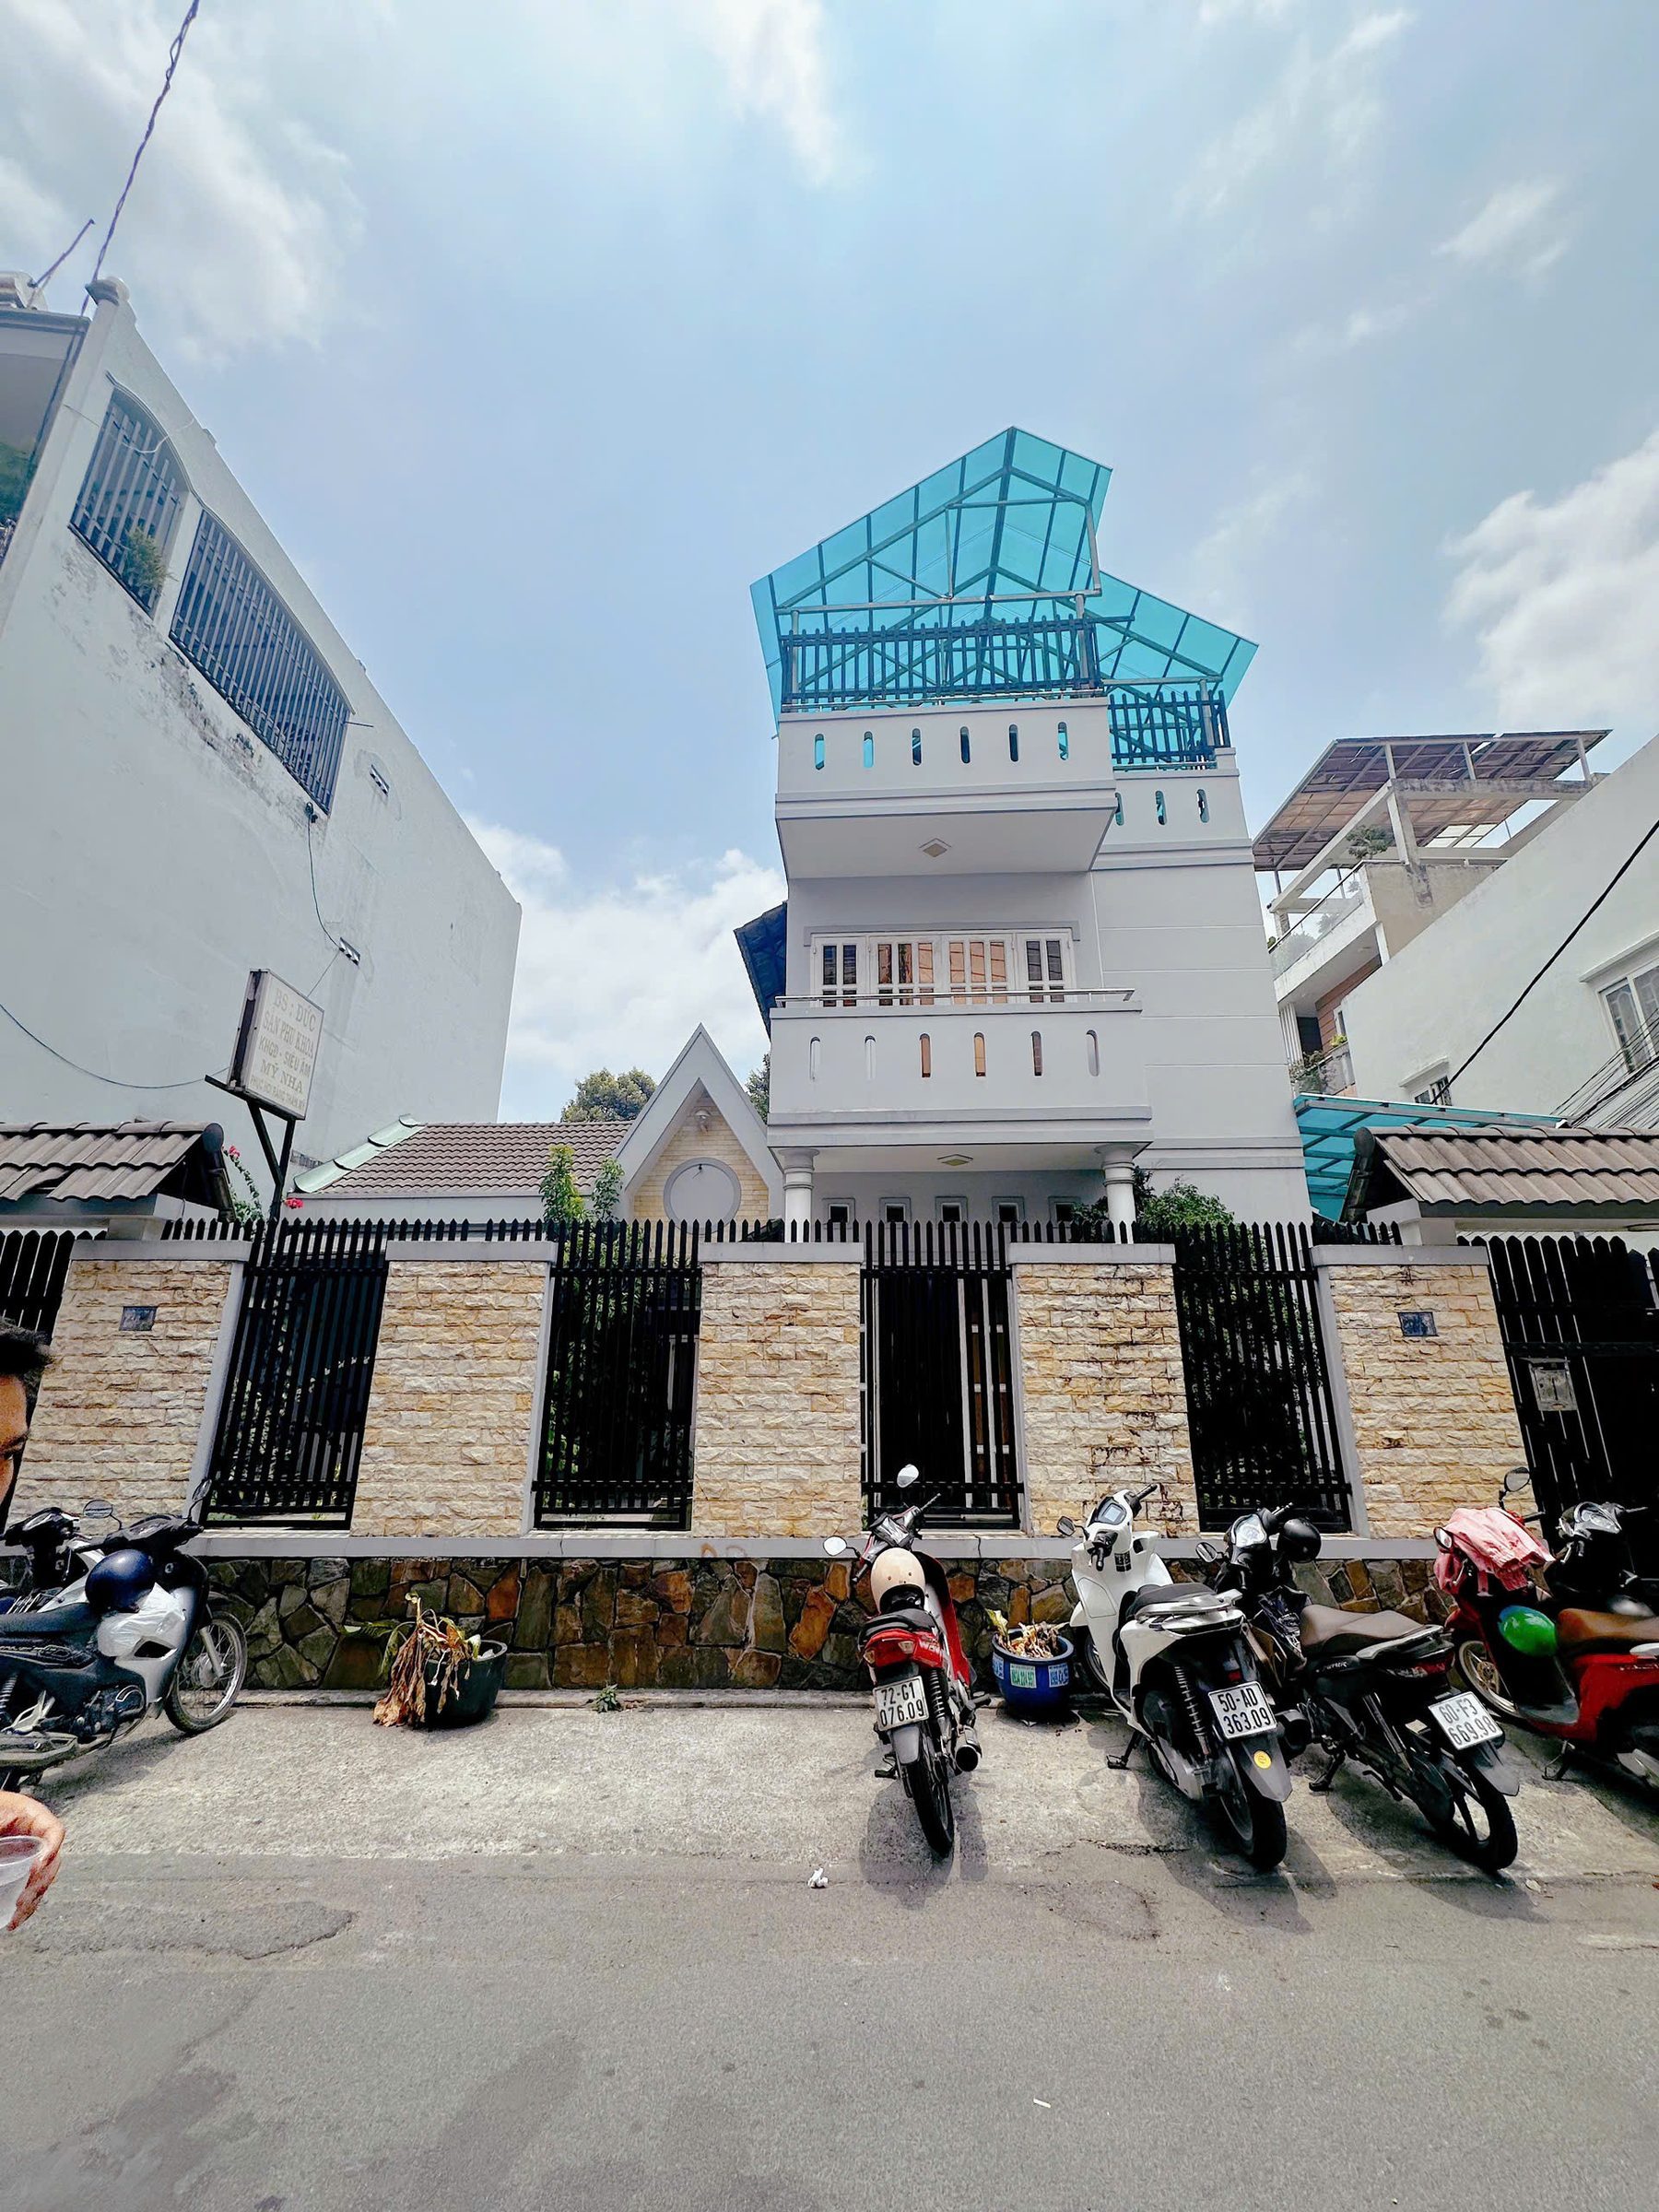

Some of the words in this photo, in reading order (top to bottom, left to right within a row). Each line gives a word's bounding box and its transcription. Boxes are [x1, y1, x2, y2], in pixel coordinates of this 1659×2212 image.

[881, 1681, 915, 1706] 72-G1
[1217, 1687, 1258, 1712] 50-AD
[879, 1699, 924, 1727] 076.09
[1223, 1707, 1272, 1735] 363.09
[1439, 1697, 1478, 1724] 60-F3
[1448, 1715, 1497, 1746] 669.98
